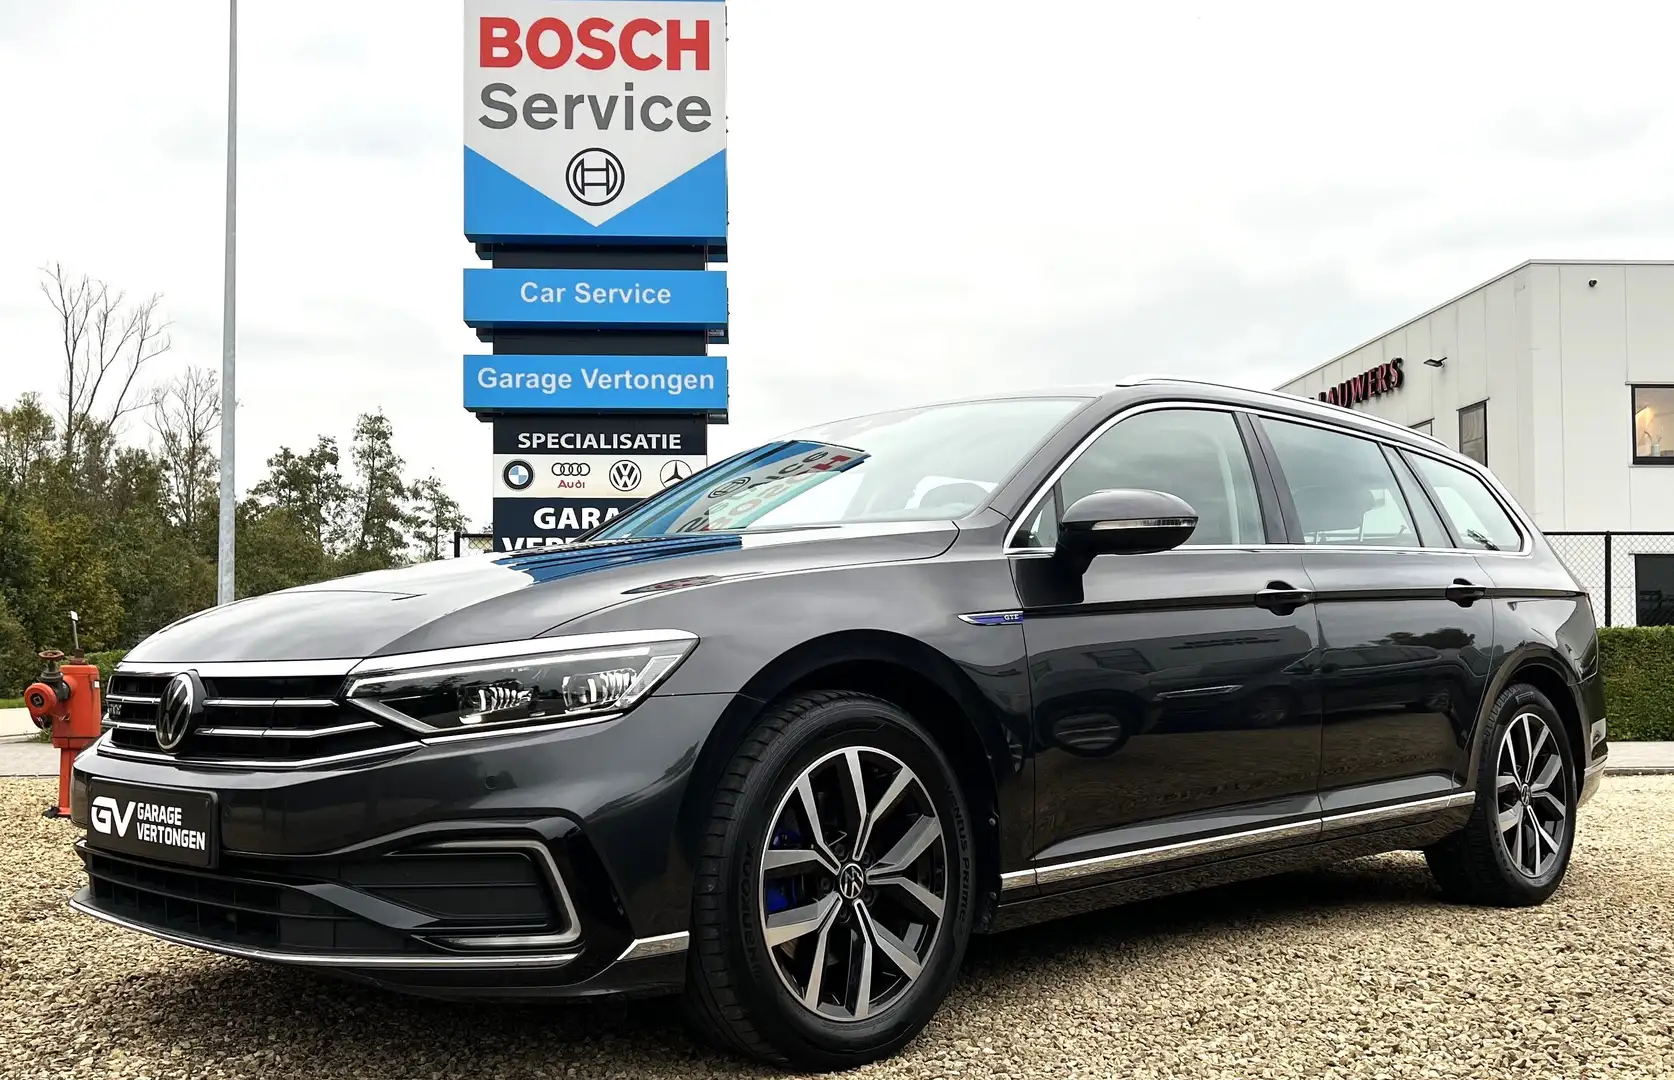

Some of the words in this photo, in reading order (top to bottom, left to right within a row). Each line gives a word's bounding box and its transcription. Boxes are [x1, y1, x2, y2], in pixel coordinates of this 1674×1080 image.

[480, 17, 710, 71] BOSCH
[478, 82, 711, 132] Service
[520, 281, 566, 303] Car
[574, 283, 671, 304] Service
[477, 367, 572, 394] Garage
[581, 368, 715, 395] Vertongen
[518, 433, 682, 450] SPECIALISATIE
[557, 480, 585, 488] Audi
[533, 507, 621, 530] GARA
[91, 795, 136, 838] GV
[137, 802, 182, 826] GARAGE
[136, 822, 206, 850] VERTONGEN
